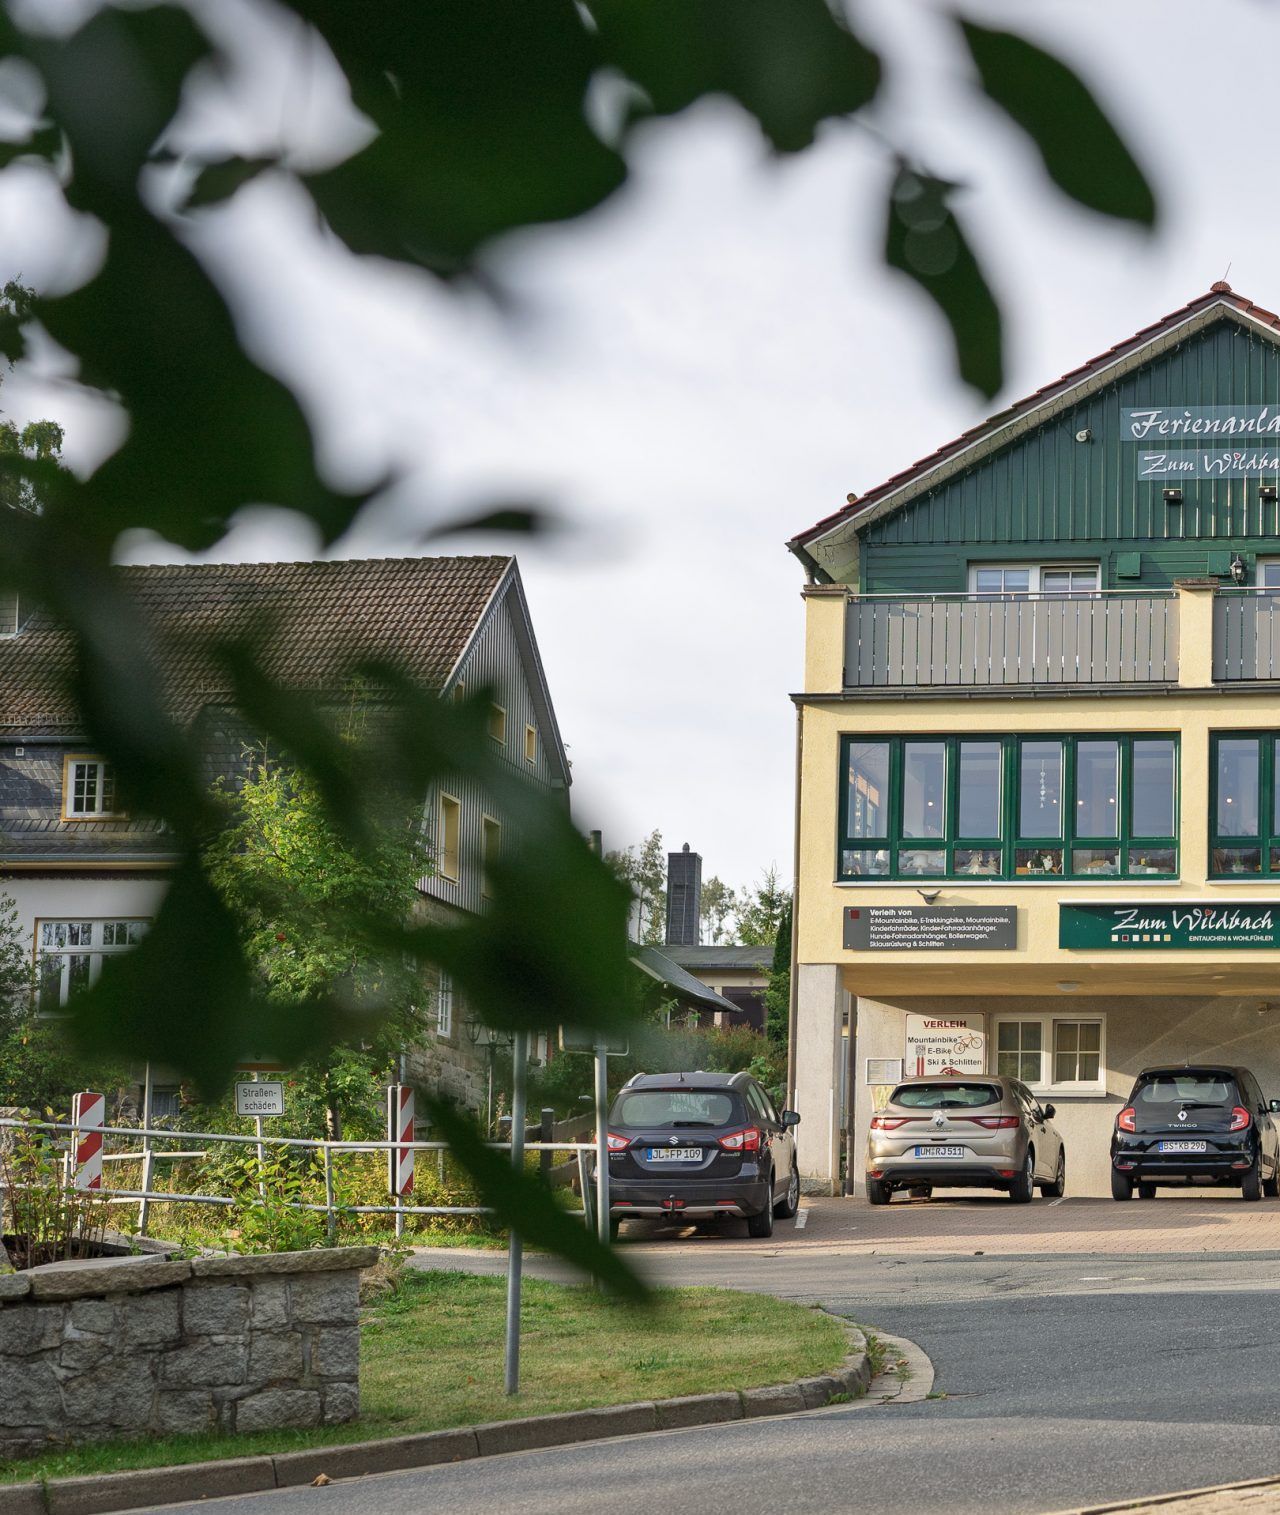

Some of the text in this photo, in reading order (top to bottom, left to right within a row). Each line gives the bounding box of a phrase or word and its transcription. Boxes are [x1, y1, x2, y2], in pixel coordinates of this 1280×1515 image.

[1141, 454, 1195, 475] Zum
[1111, 908, 1274, 931] Zum Wildbach
[1232, 934, 1274, 942] WOHLFÜHLEN
[923, 1020, 967, 1028] VERLEIH
[927, 1058, 982, 1066] Ski & Schlitten
[242, 1088, 277, 1098] Straßen-
[244, 1101, 277, 1110] schäden
[1190, 1142, 1206, 1150] 296
[652, 1149, 701, 1159] JL FP 109
